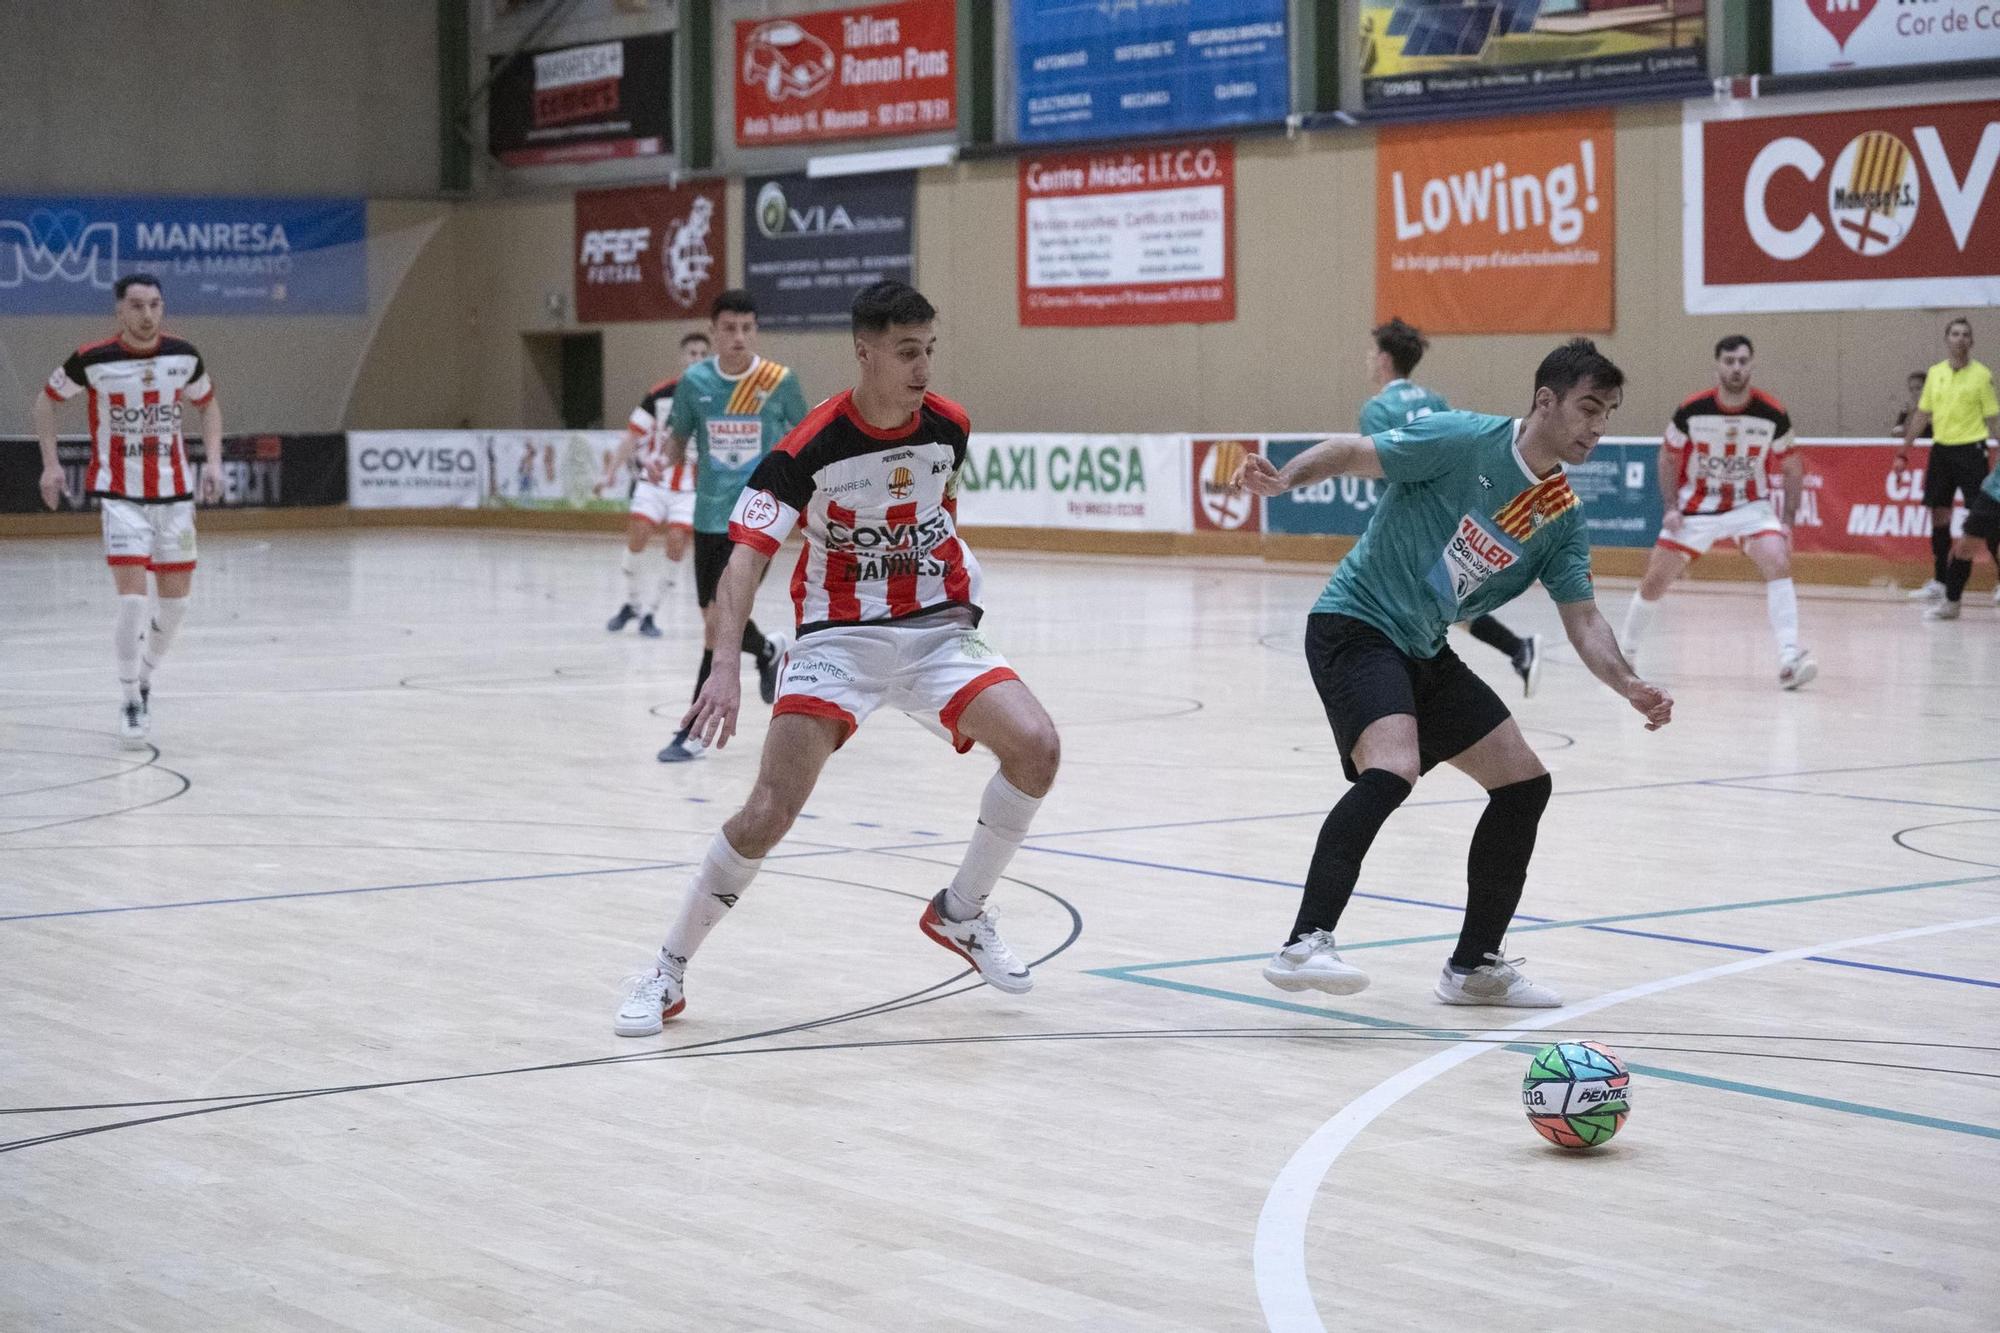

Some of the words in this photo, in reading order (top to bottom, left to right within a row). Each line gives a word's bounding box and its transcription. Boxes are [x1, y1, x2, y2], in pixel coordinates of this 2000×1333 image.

[842, 16, 900, 47] Tallers
[1896, 12, 1936, 36] Cor
[1941, 8, 1969, 33] de
[841, 53, 903, 86] Ramon
[904, 46, 949, 80] Pons
[1027, 162, 1085, 192] Centre
[1088, 154, 1146, 187] Mèdic
[135, 223, 291, 252] MANRESA
[580, 227, 651, 265] RFEF
[587, 264, 643, 284] FUTSAL
[710, 422, 758, 434] TALLER
[1047, 446, 1146, 493] CASA
[1452, 536, 1474, 564] San
[1462, 518, 1513, 571] TALLER
